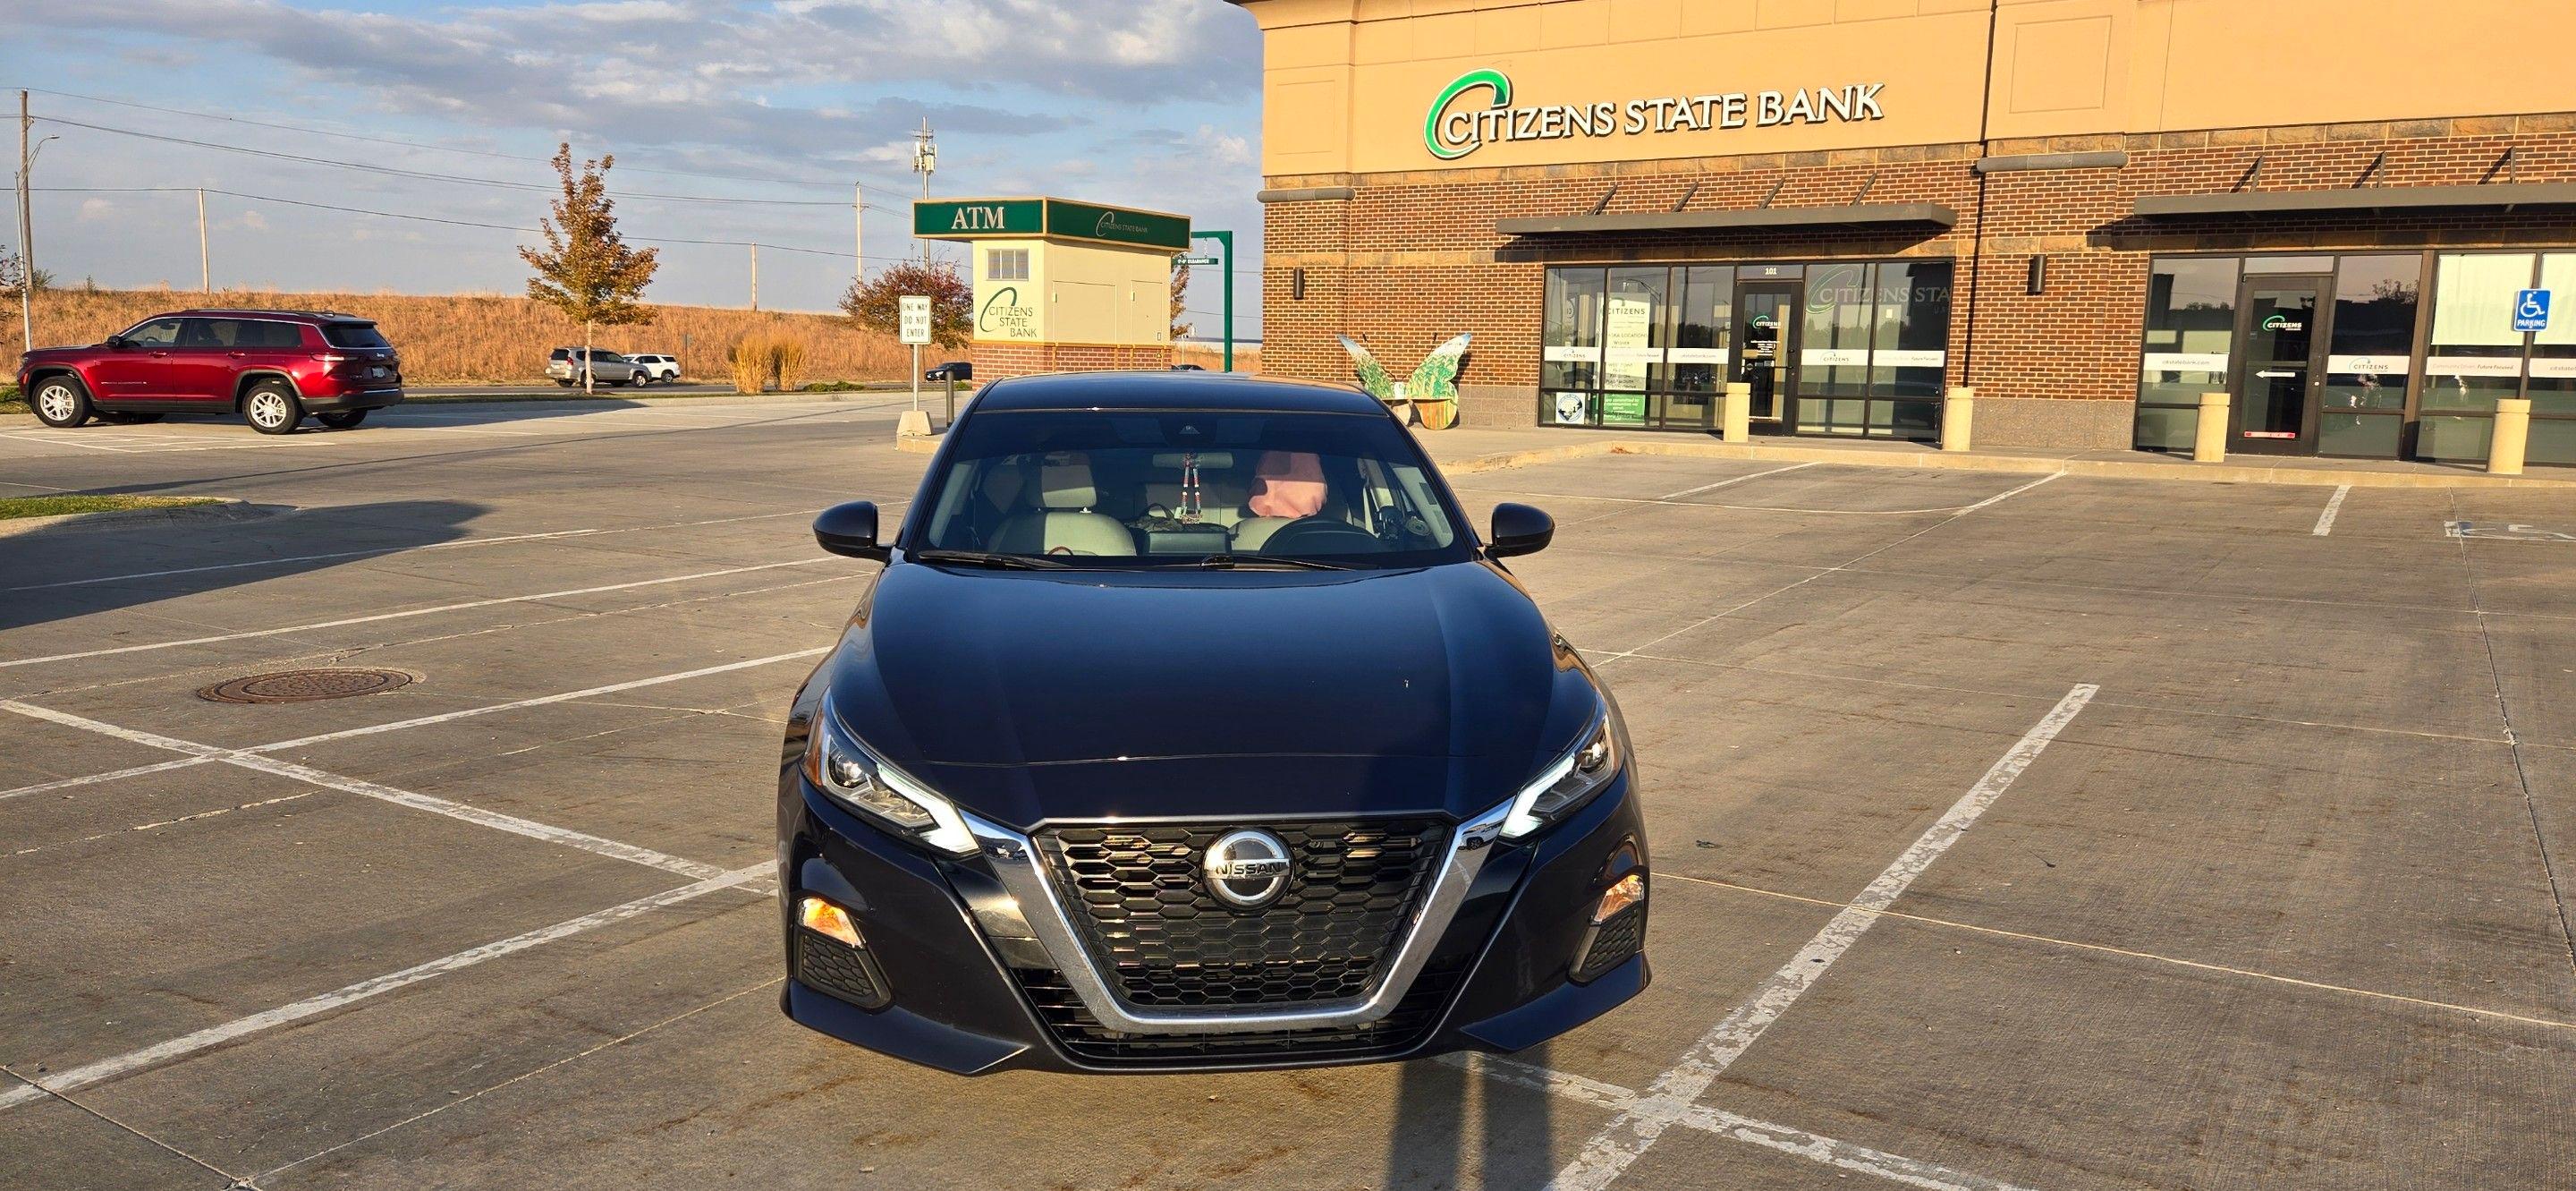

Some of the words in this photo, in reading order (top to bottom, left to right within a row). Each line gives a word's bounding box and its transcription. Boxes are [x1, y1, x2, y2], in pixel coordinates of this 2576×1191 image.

[1444, 102, 1616, 143] CITIZENS
[1624, 92, 1747, 134] STATE
[1756, 82, 1885, 128] BANK
[951, 206, 1005, 230] ATM
[1123, 224, 1135, 233] STATE
[1765, 267, 1777, 275] 101
[902, 302, 914, 311] ONE
[917, 302, 928, 311] WAY
[988, 306, 1033, 316] CITIZENS
[903, 316, 913, 325] DO
[915, 316, 927, 325] NOT
[999, 318, 1028, 327] STATE
[2517, 319, 2546, 328] PARKING
[906, 328, 925, 337] ENTER
[1010, 328, 1038, 337] BANK
[1216, 862, 1282, 875] NISSAN
